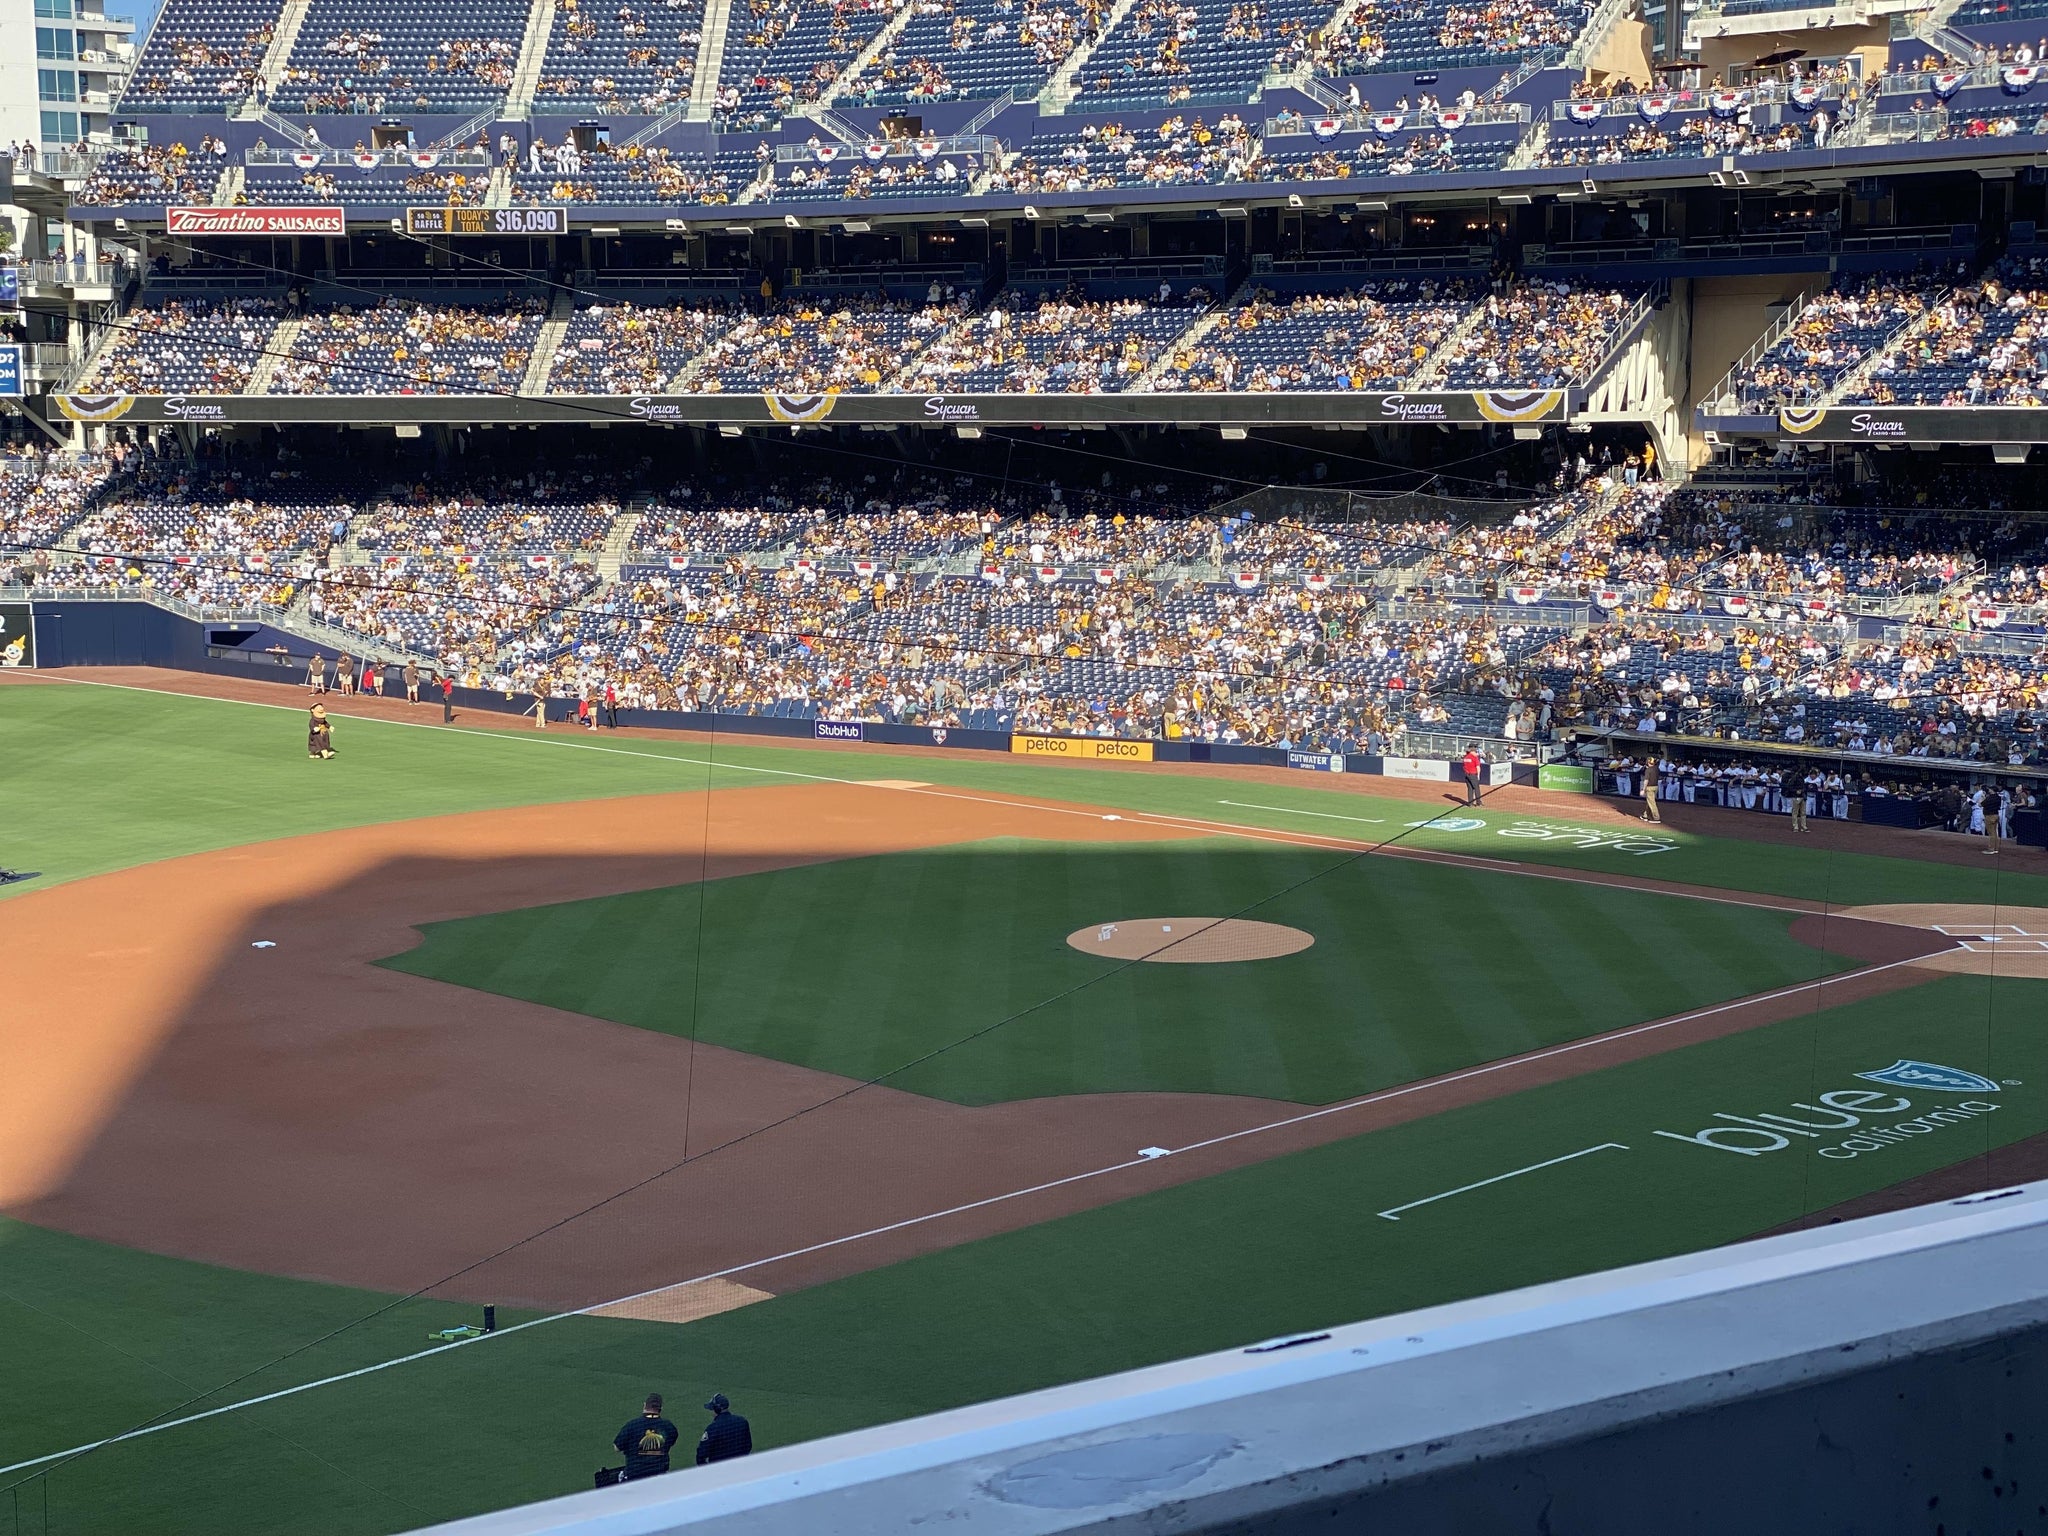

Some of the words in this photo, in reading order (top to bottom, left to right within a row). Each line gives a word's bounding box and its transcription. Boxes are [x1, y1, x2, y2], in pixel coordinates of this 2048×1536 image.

[171, 210, 264, 231] Tarantino
[268, 217, 341, 230] SAUSAGES
[415, 220, 443, 229] RAFFLE
[456, 210, 490, 220] TODAY'S
[495, 209, 557, 232] $16,090
[461, 221, 486, 232] TOTAL
[163, 397, 223, 420] Sycuan
[629, 397, 681, 420] Sycuan
[924, 396, 978, 421] Sycuan
[1381, 394, 1445, 421] Sycuan
[1850, 413, 1905, 437] Sycuan
[818, 724, 859, 737] StubHub
[1026, 737, 1067, 752] petco
[1096, 740, 1139, 757] petco
[1290, 754, 1327, 765] CUTWATER
[1652, 1089, 1912, 1156] blue
[1817, 1100, 2002, 1159] california
